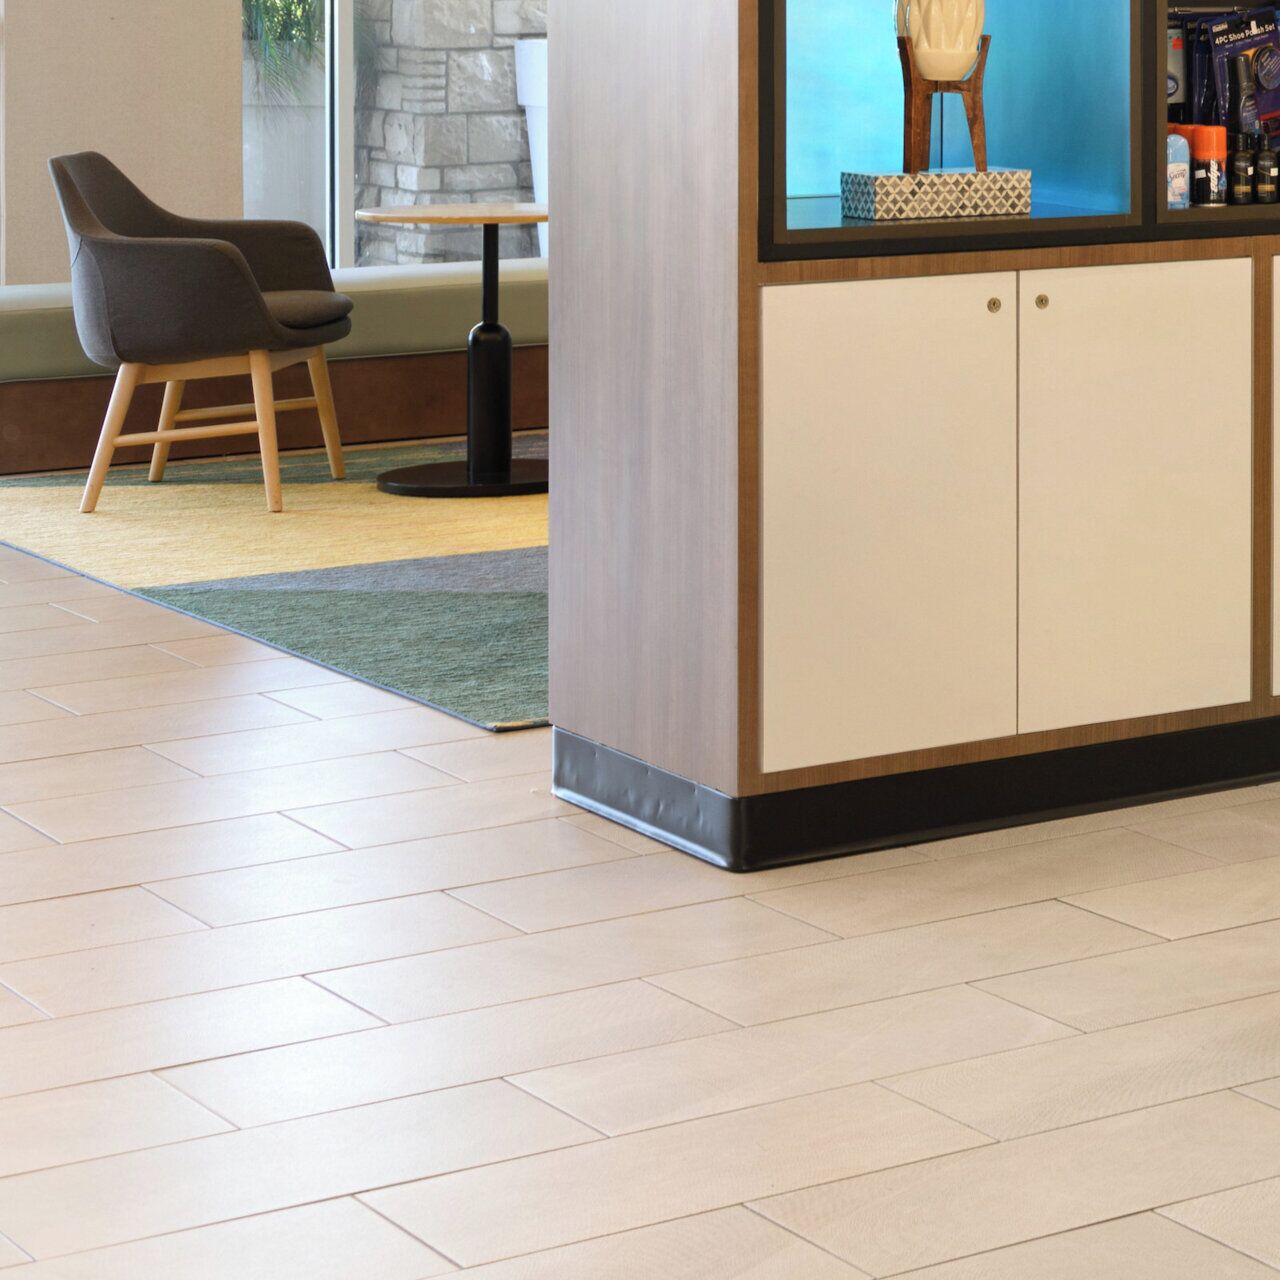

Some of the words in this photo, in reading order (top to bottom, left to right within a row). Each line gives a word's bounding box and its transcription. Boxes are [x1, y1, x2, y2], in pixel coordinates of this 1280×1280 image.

[1215, 33, 1229, 45] 4PC
[1229, 29, 1245, 41] Shoe
[1265, 23, 1276, 32] Set
